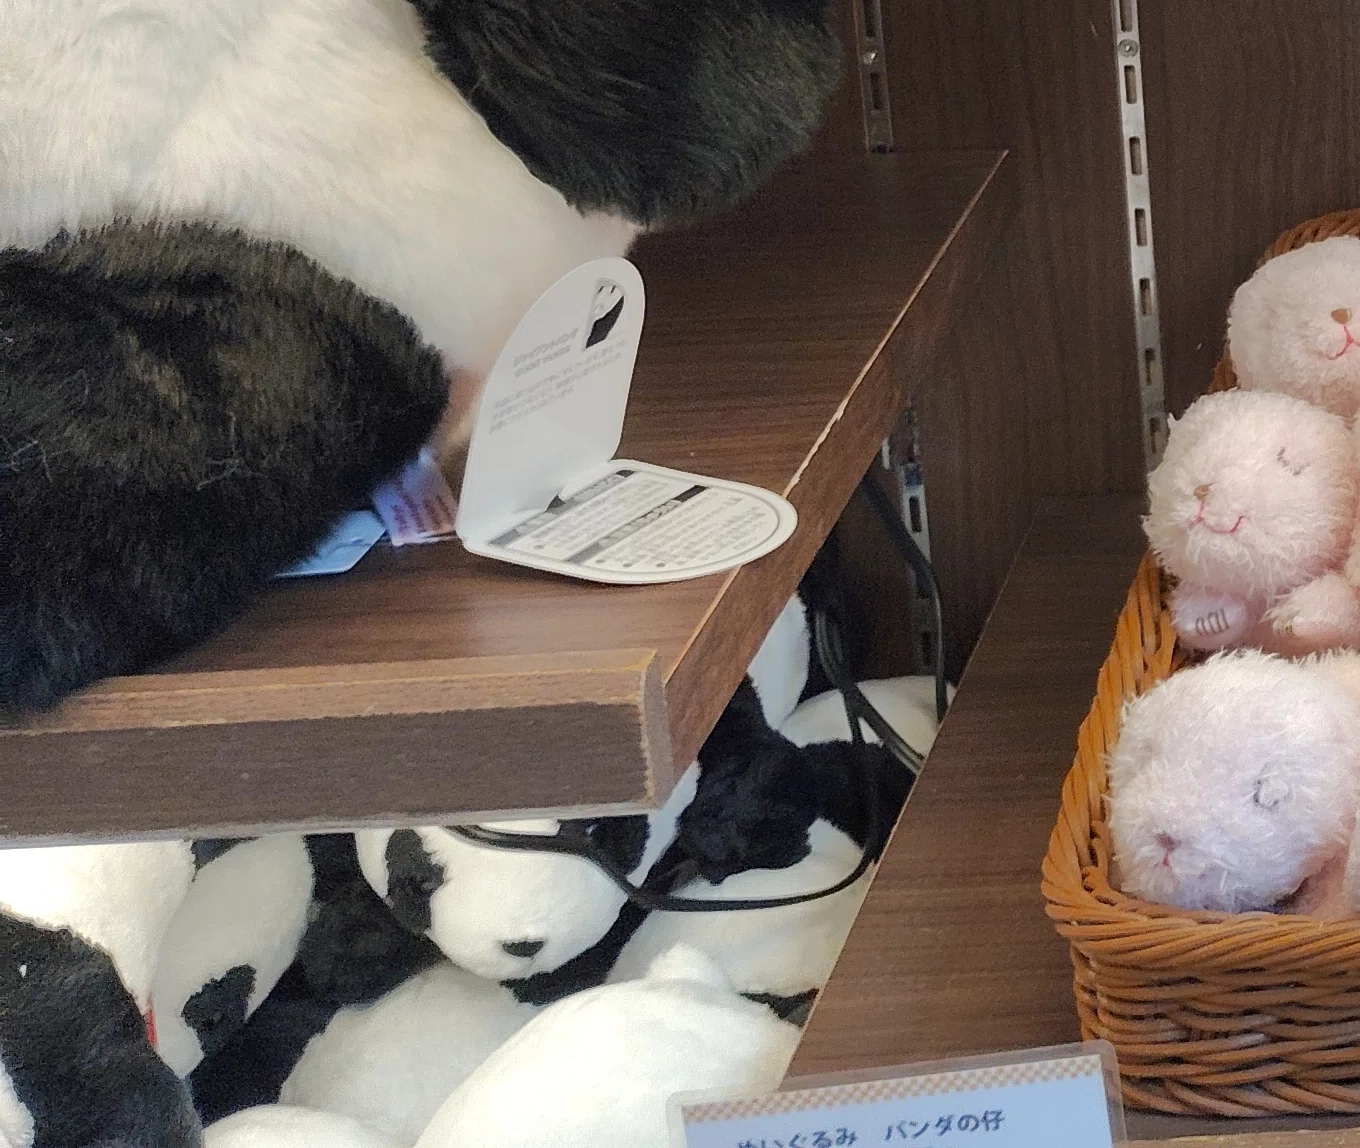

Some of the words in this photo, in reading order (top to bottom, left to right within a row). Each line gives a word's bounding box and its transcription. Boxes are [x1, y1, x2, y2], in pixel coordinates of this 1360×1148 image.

[884, 1109, 1004, 1141] パンダの仔
